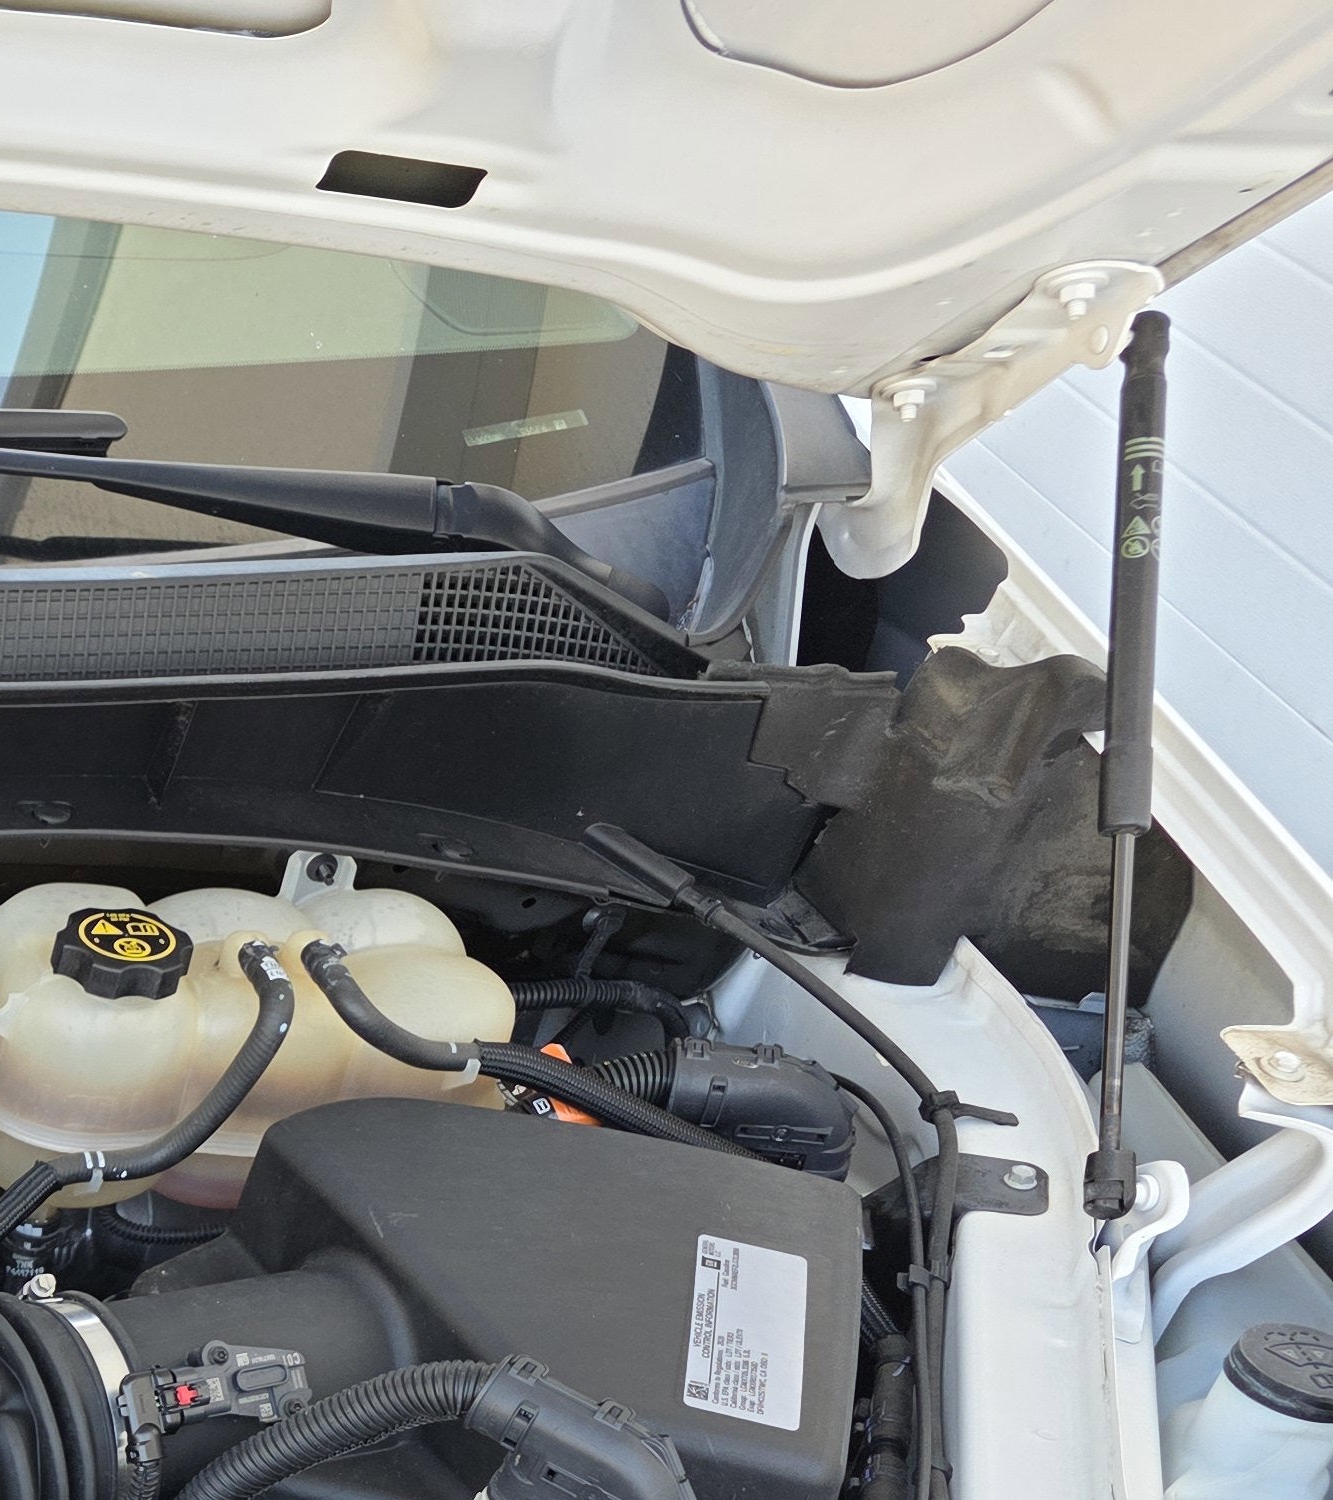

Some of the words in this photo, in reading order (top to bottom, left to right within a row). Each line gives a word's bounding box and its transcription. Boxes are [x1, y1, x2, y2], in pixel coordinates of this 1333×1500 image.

[696, 1293, 705, 1321] EMISSION
[705, 1288, 715, 1328] INFORMATION
[693, 1322, 703, 1347] VEHICLE
[702, 1330, 712, 1358] CONTROL
